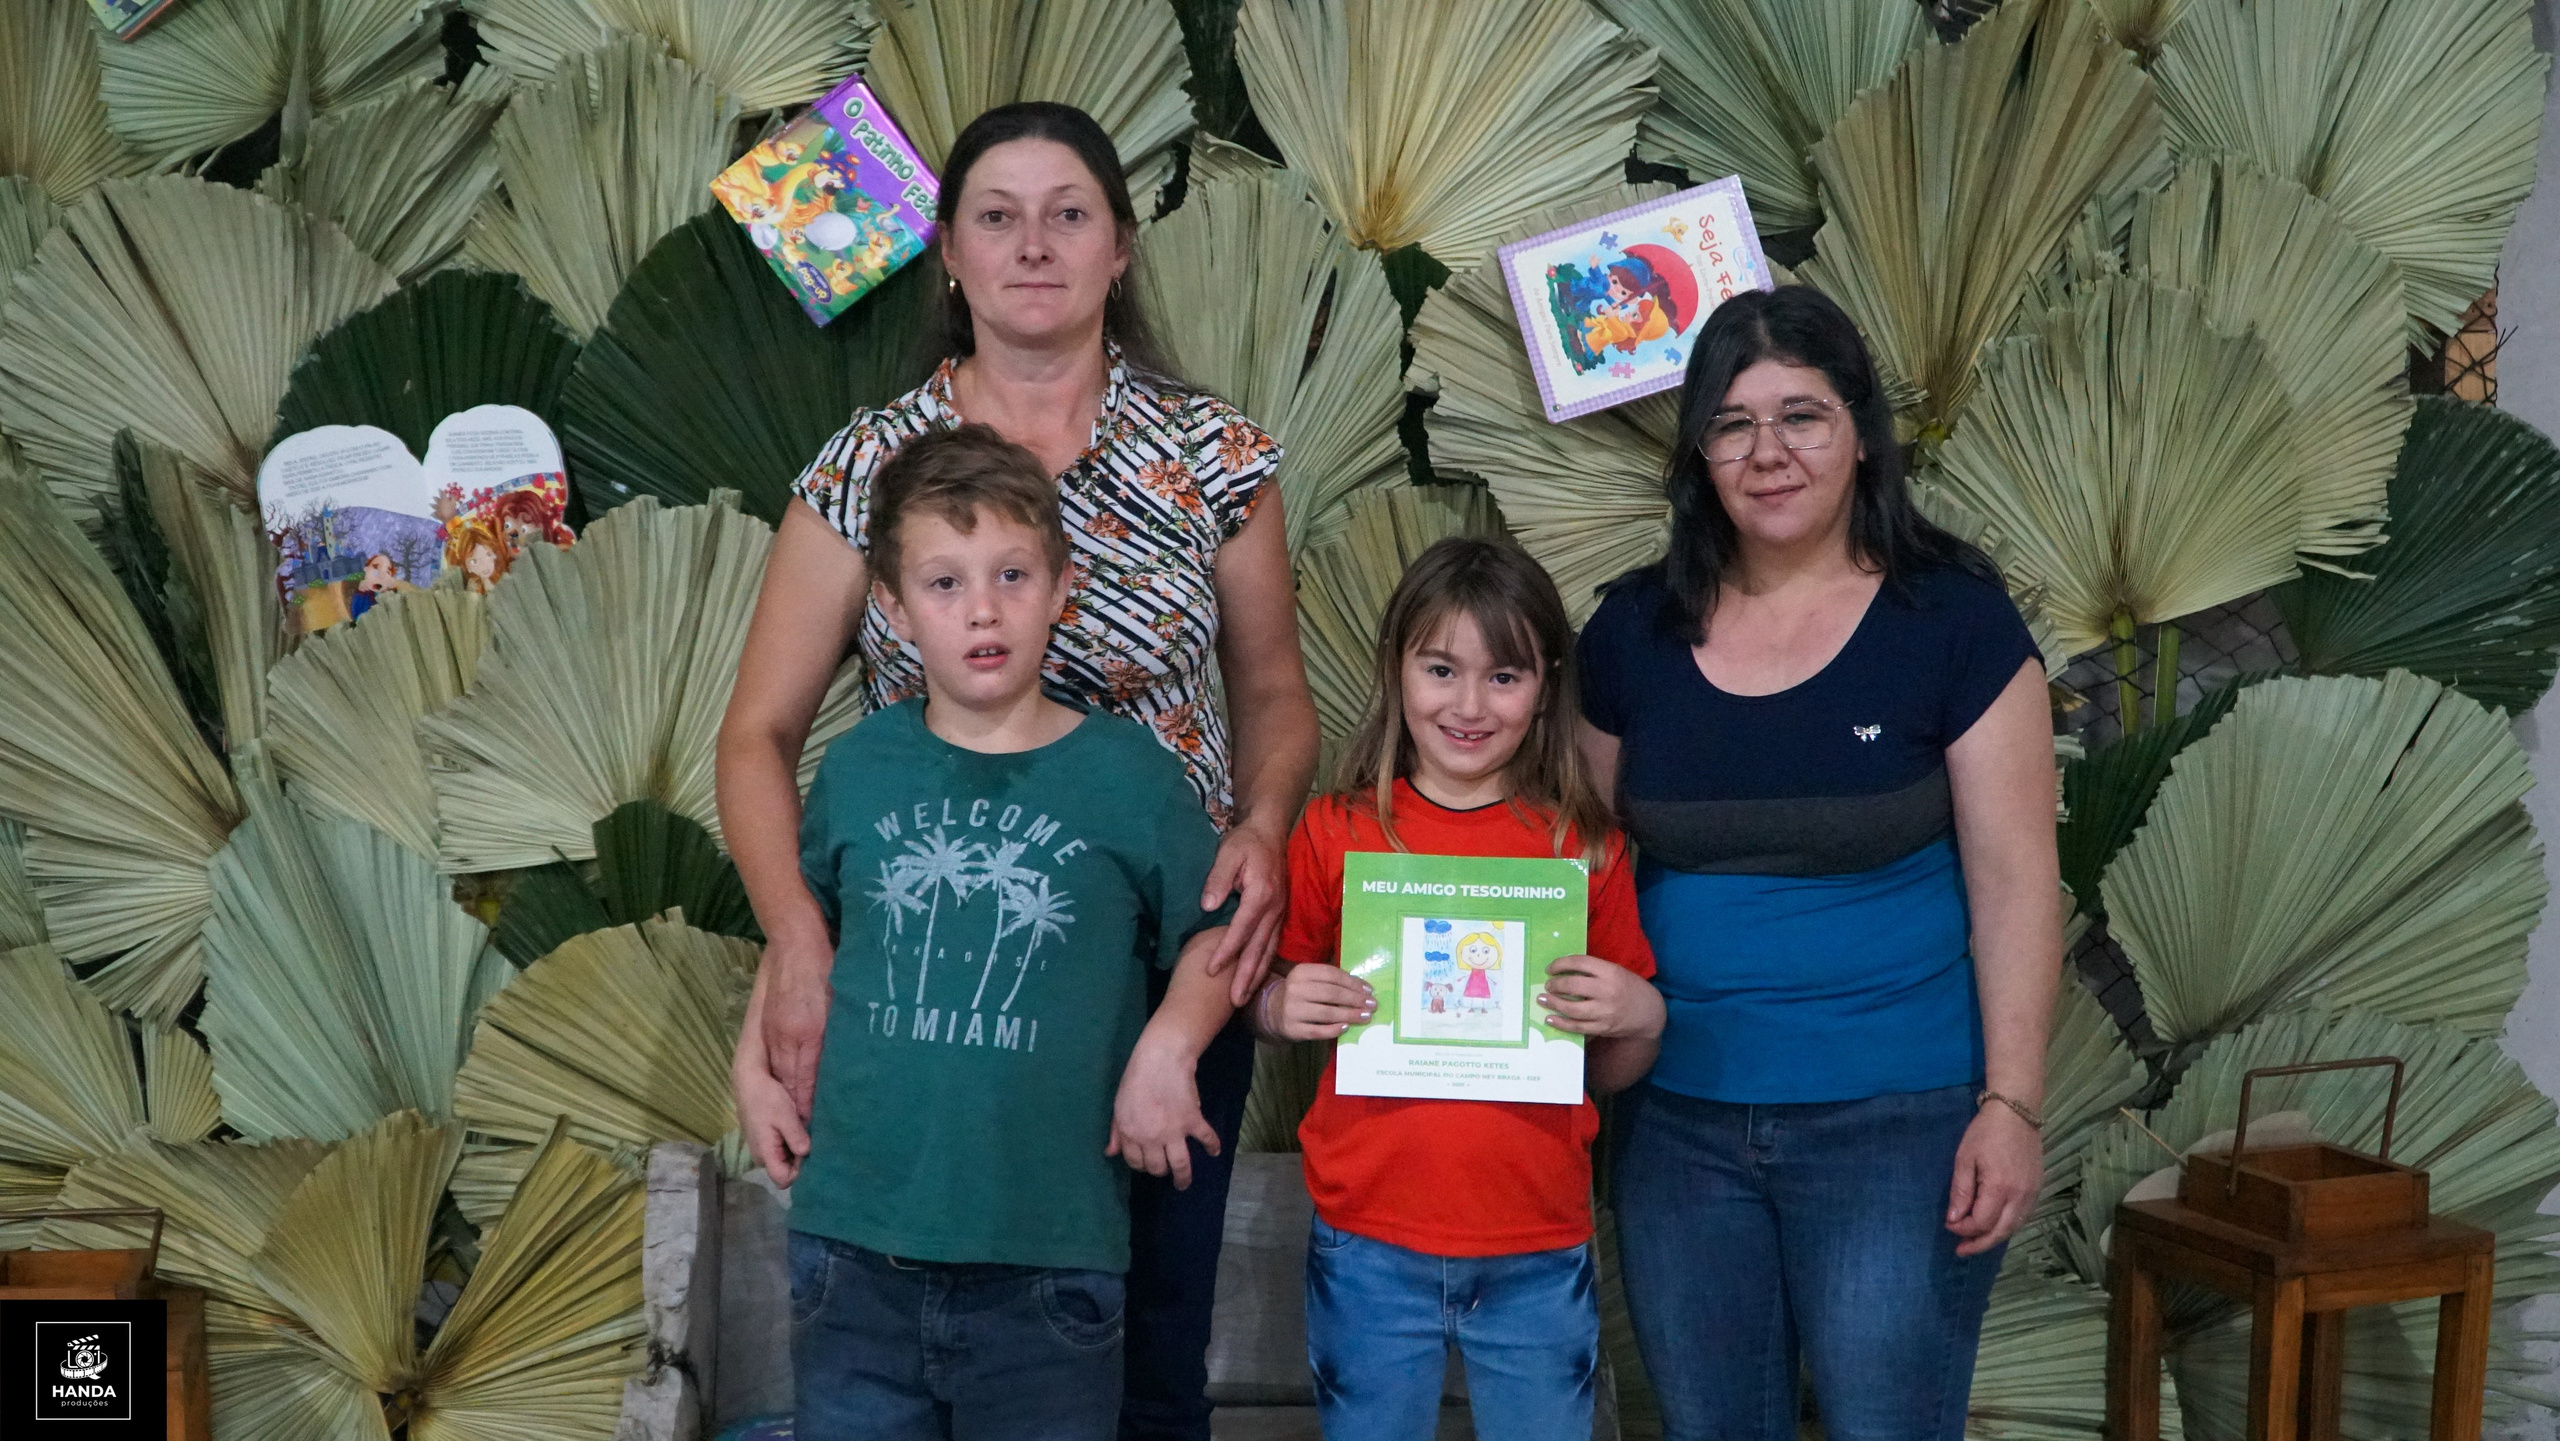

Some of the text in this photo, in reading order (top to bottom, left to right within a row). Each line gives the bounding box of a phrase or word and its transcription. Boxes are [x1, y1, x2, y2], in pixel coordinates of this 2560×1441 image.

[844, 97, 864, 118] O
[1699, 214, 1723, 266] Seja
[874, 797, 1088, 866] WELCOME
[1362, 881, 1566, 899] MEU AMIGO TESOURINHO
[868, 1002, 1037, 1053] TO MIAMI
[1408, 1059, 1440, 1067] RAIANE
[1483, 1062, 1510, 1070] KETES
